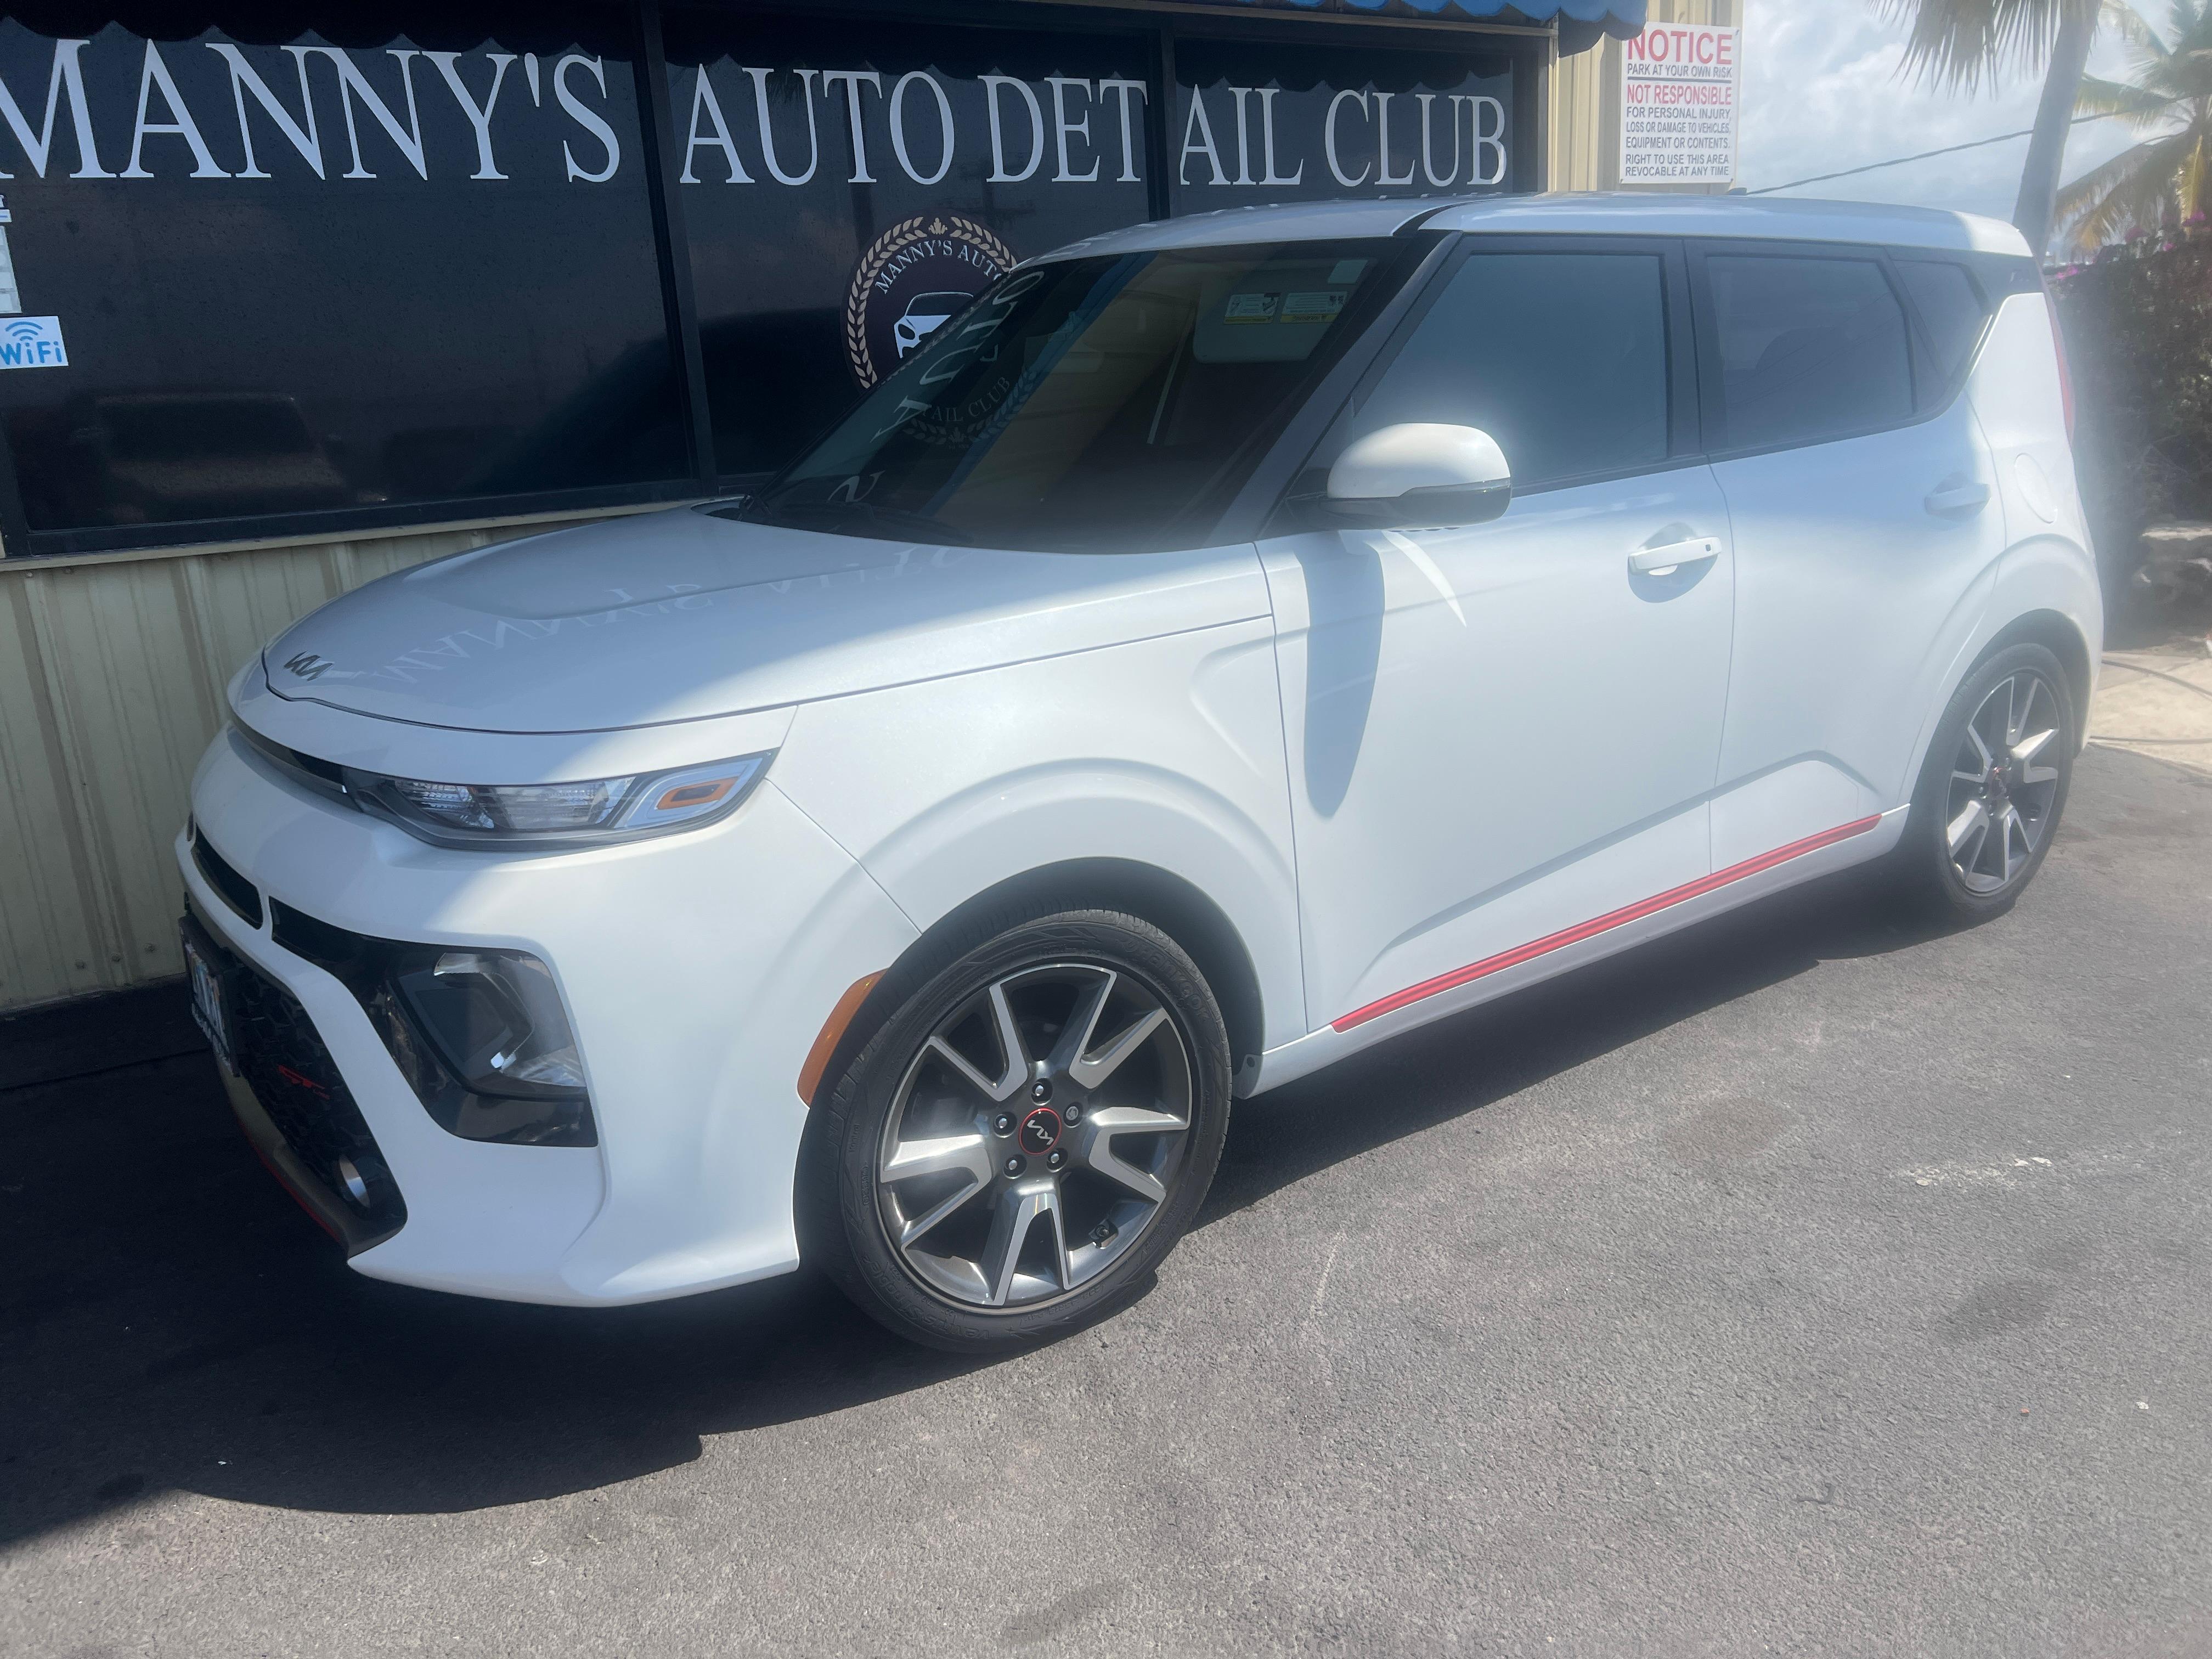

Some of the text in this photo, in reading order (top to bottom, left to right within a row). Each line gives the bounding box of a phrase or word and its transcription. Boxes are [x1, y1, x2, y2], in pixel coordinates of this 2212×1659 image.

[1628, 29, 1732, 65] NOTICE
[1627, 63, 1732, 78] PARK AT YOUR OWN RISK
[1627, 84, 1731, 105] NOT RESPONSIBLE
[0, 39, 620, 183] MANNY'S
[680, 63, 955, 185] AUTO
[1325, 89, 1507, 187] CLUB
[1627, 106, 1645, 118] FOR
[1648, 107, 1697, 119] PERSONAL
[1626, 121, 1644, 132] LOSS
[1646, 121, 1656, 132] OR
[1657, 122, 1686, 133] DAMAGE
[1688, 122, 1696, 133] TO
[1626, 137, 1672, 149] EQUIPMENT
[1674, 137, 1685, 149] OR
[1626, 154, 1729, 165] RIGHT TO USE THIS AREA
[1626, 166, 1729, 176] REVOCABLE AT ANY TIME
[875, 240, 952, 294] MANNY'S
[0, 341, 62, 365] WiFi
[967, 377, 1010, 417] CLUB
